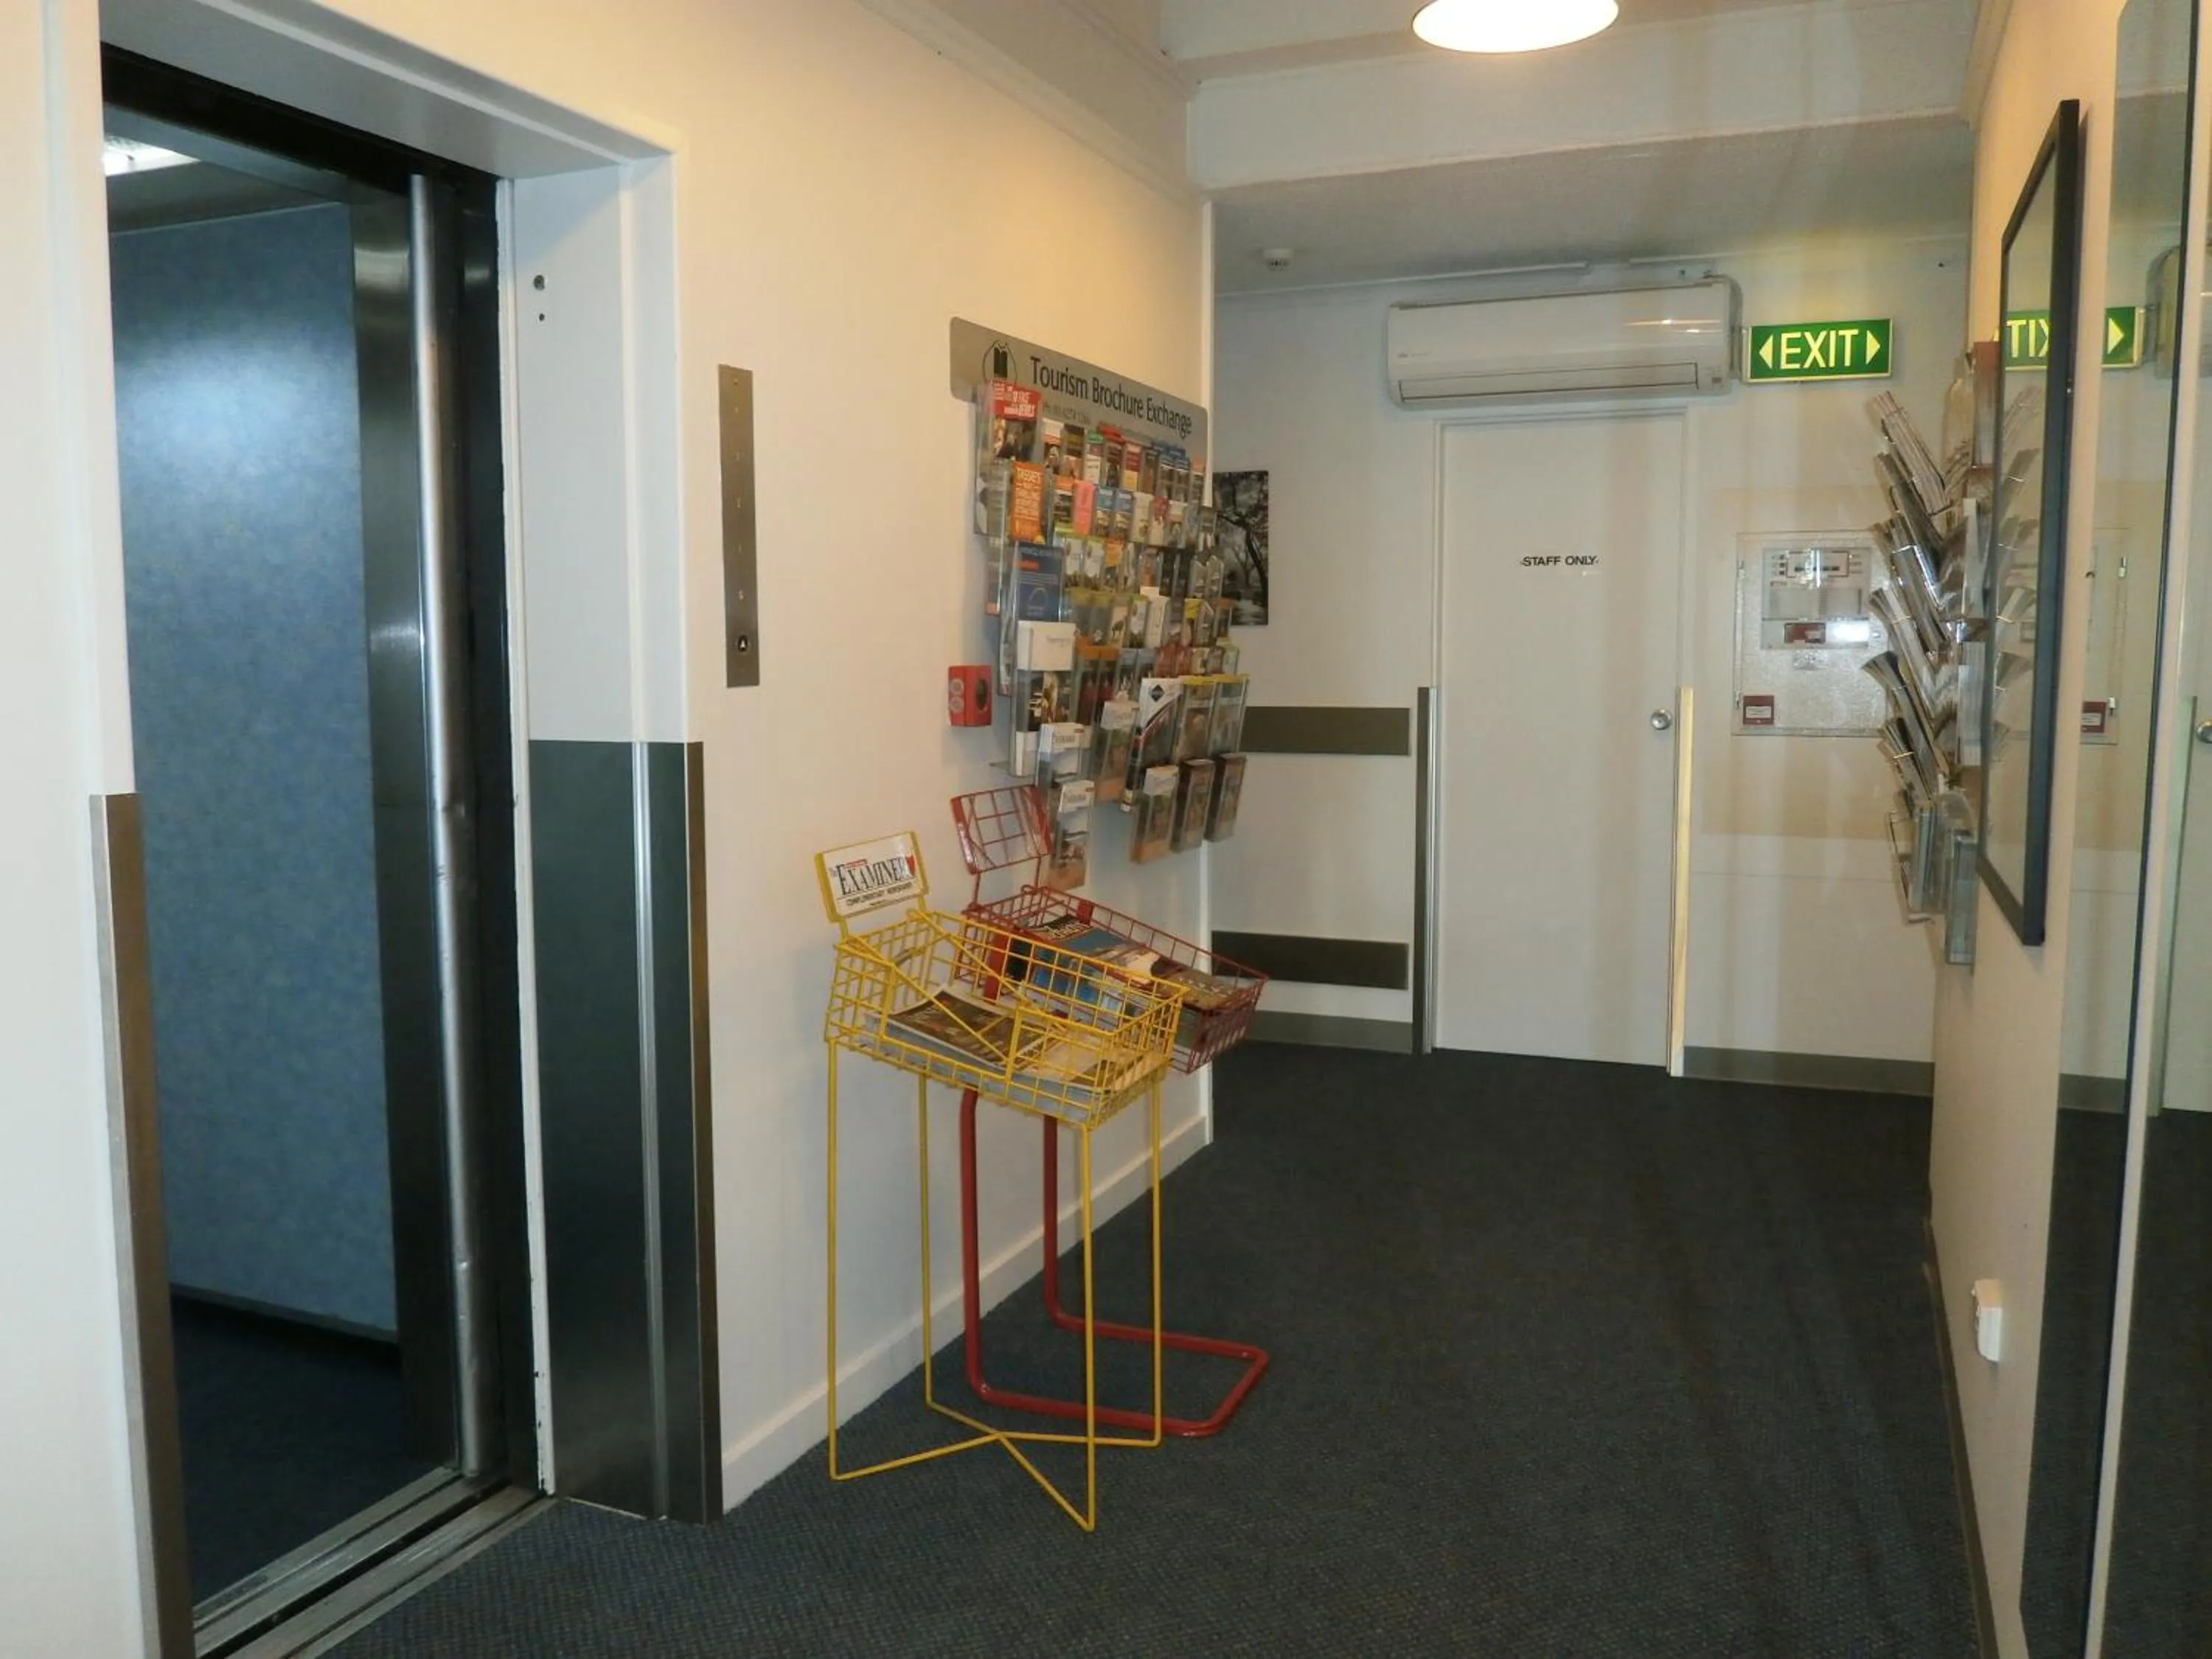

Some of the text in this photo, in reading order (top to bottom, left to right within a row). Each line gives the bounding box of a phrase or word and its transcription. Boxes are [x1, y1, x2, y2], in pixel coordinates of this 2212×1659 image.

[1780, 329, 1859, 369] EXIT
[1029, 355, 1089, 400] Tourism
[1092, 376, 1144, 420] Brochure
[1146, 396, 1192, 440] Exchange
[1520, 555, 1597, 567] STAFF ONLY
